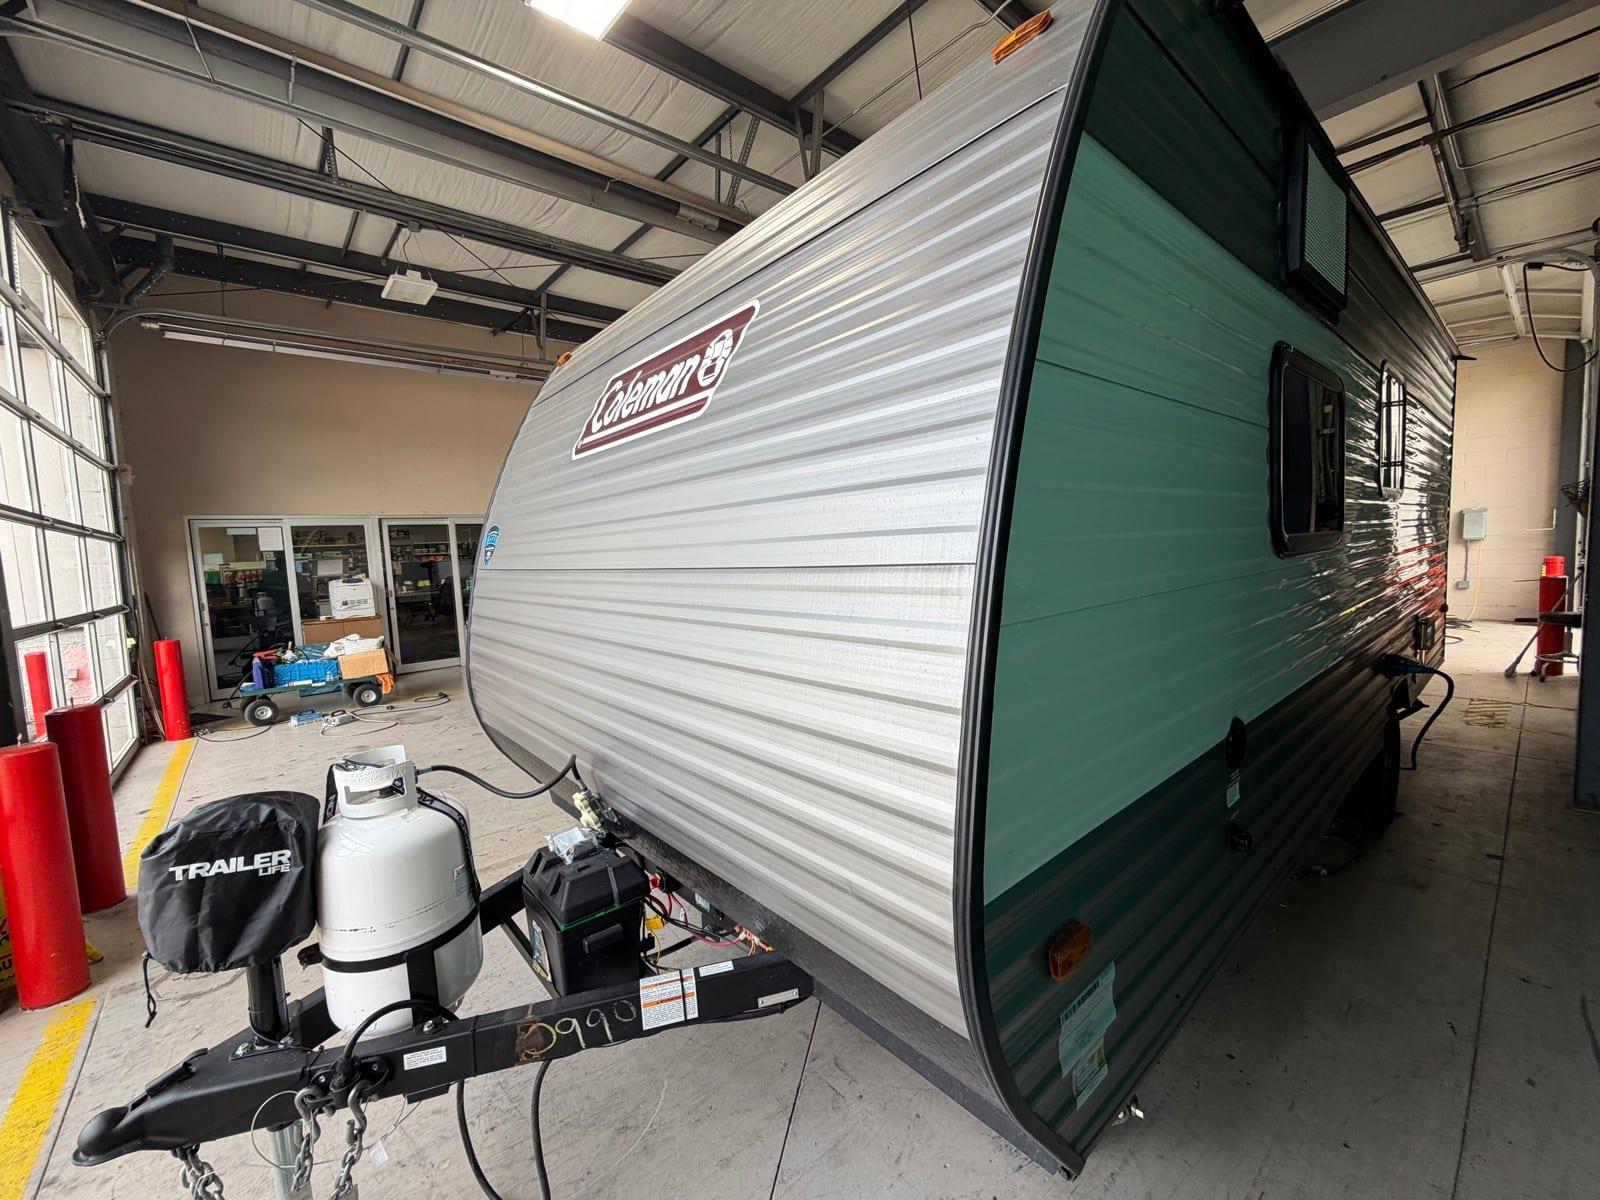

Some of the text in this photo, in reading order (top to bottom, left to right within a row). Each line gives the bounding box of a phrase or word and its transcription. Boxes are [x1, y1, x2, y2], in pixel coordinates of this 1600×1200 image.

[592, 354, 701, 433] Coleman
[168, 849, 292, 882] TRAILER
[258, 863, 291, 877] LIFE
